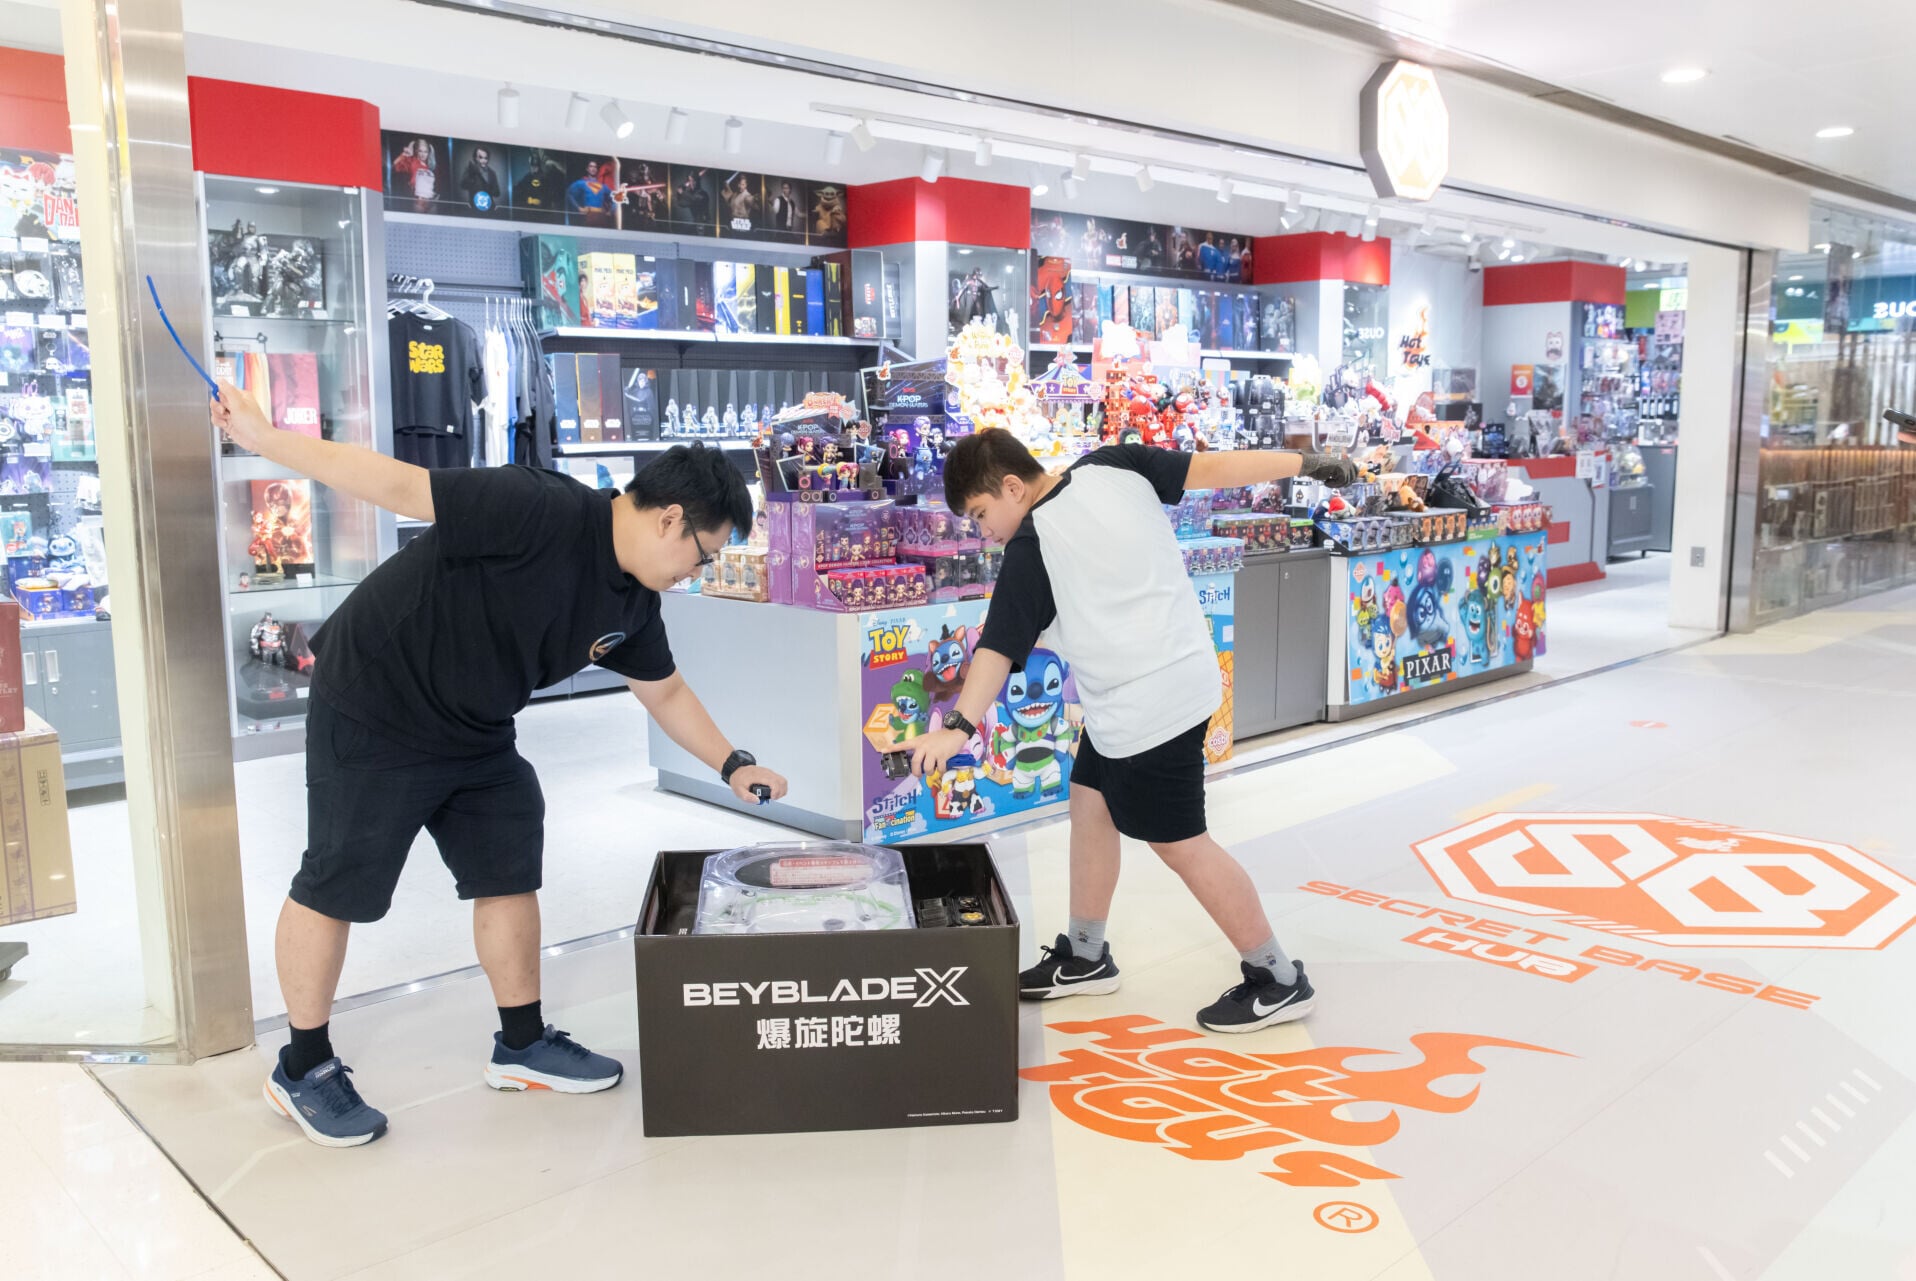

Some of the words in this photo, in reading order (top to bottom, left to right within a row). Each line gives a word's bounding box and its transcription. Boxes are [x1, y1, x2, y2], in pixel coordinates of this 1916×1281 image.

[868, 625, 911, 654] TOY
[873, 651, 905, 663] STORY
[1406, 653, 1451, 679] PIXAR
[1298, 880, 1571, 946] SECRET
[1578, 943, 1822, 1012] BASE
[1417, 930, 1583, 978] HUB
[756, 1013, 901, 1050] 爆旋陀螺
